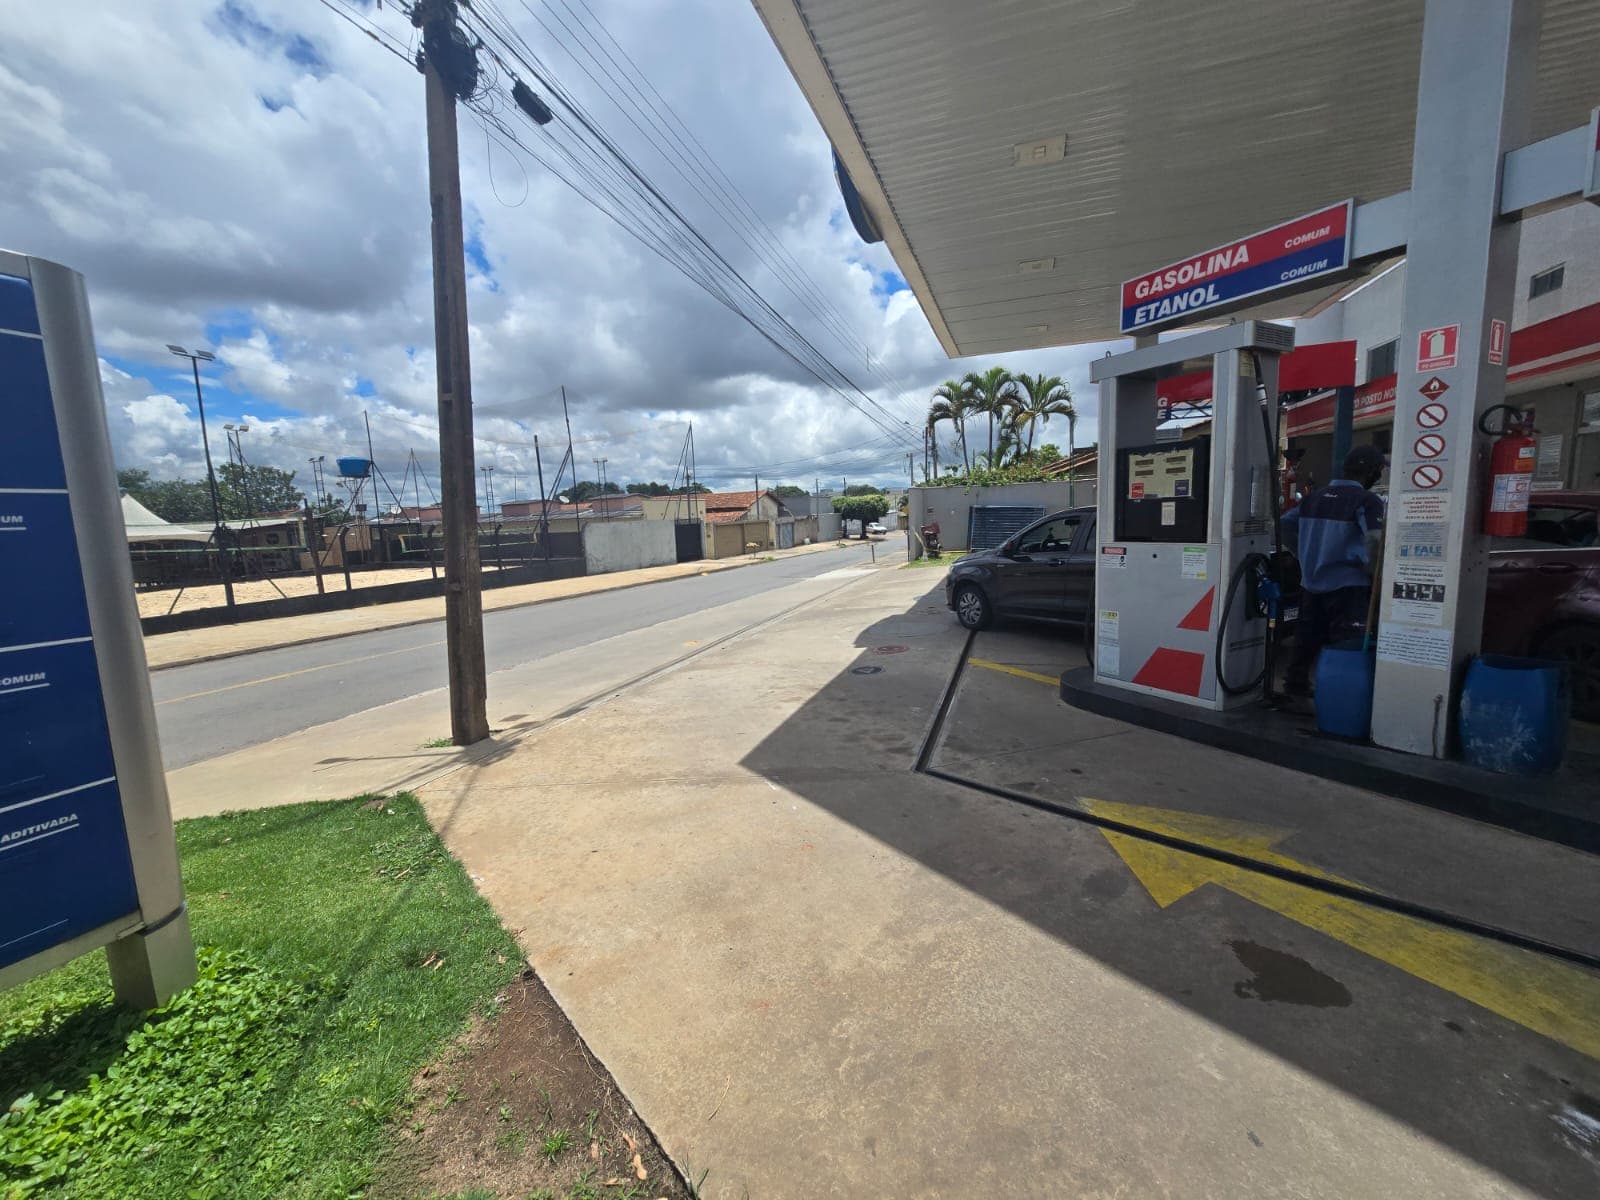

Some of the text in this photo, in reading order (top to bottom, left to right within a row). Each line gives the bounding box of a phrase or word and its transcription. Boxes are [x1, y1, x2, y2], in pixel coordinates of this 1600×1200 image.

[1135, 225, 1331, 299] GASOLINA COMUM
[1134, 258, 1328, 325] ETANOL COMUM
[0, 671, 46, 687] OMUM
[0, 813, 79, 843] ADITIVADA
